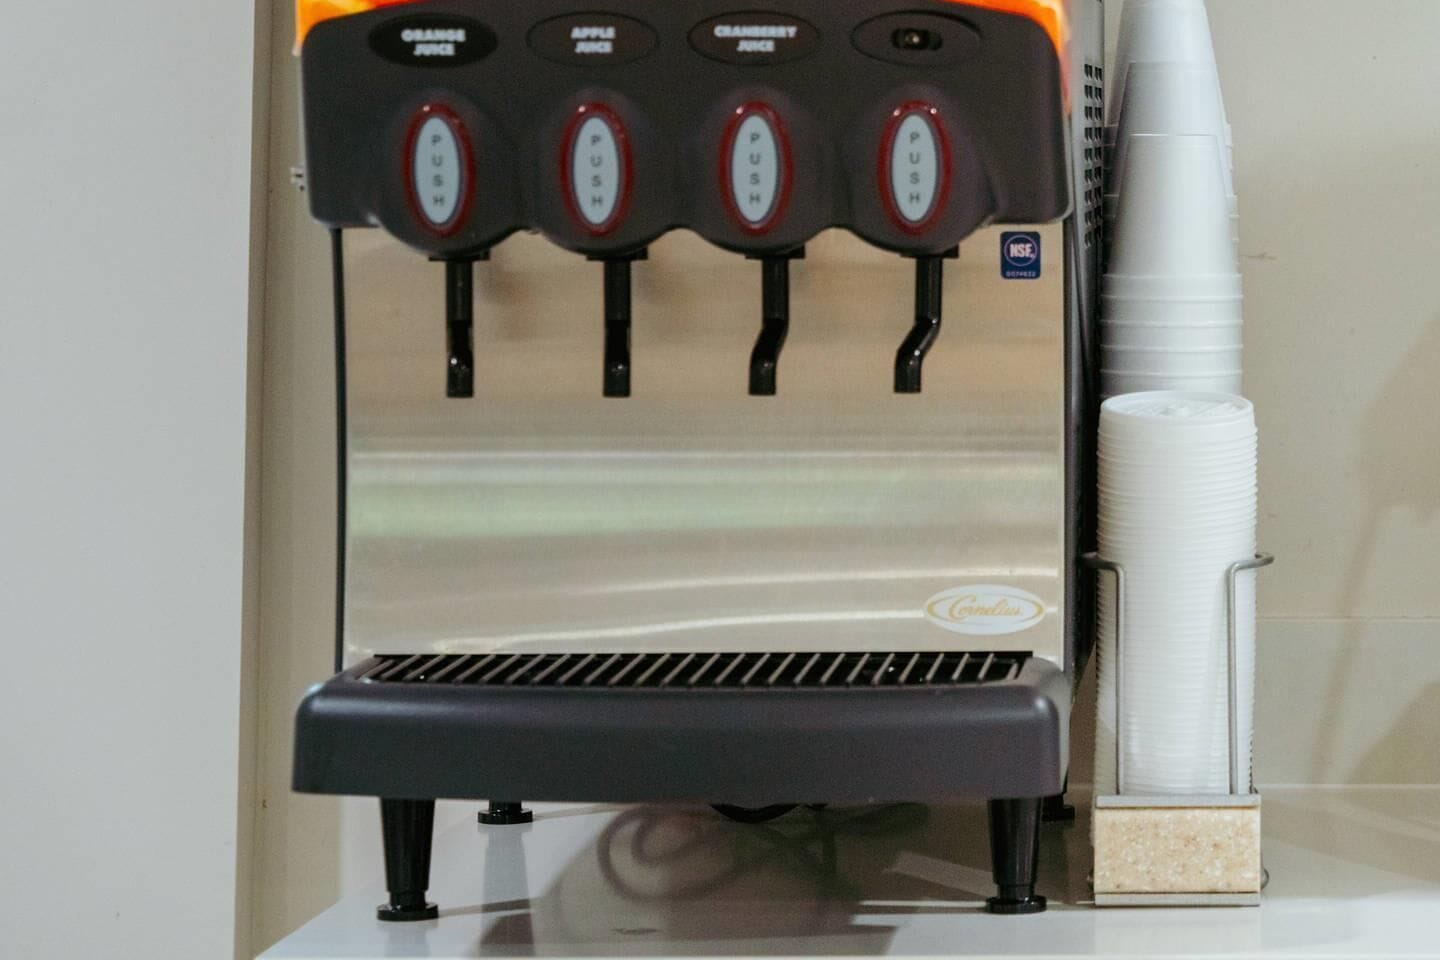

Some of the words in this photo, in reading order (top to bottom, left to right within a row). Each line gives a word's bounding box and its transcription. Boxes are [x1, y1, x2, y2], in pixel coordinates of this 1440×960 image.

[401, 28, 466, 42] ORANGE
[570, 26, 616, 39] APPLE
[713, 24, 798, 38] CRANBERRY
[413, 42, 455, 56] JUICE
[575, 40, 613, 54] JUICE
[736, 40, 775, 52] JUICE
[1009, 242, 1034, 258] NSF
[948, 594, 1021, 624] Cornelius
